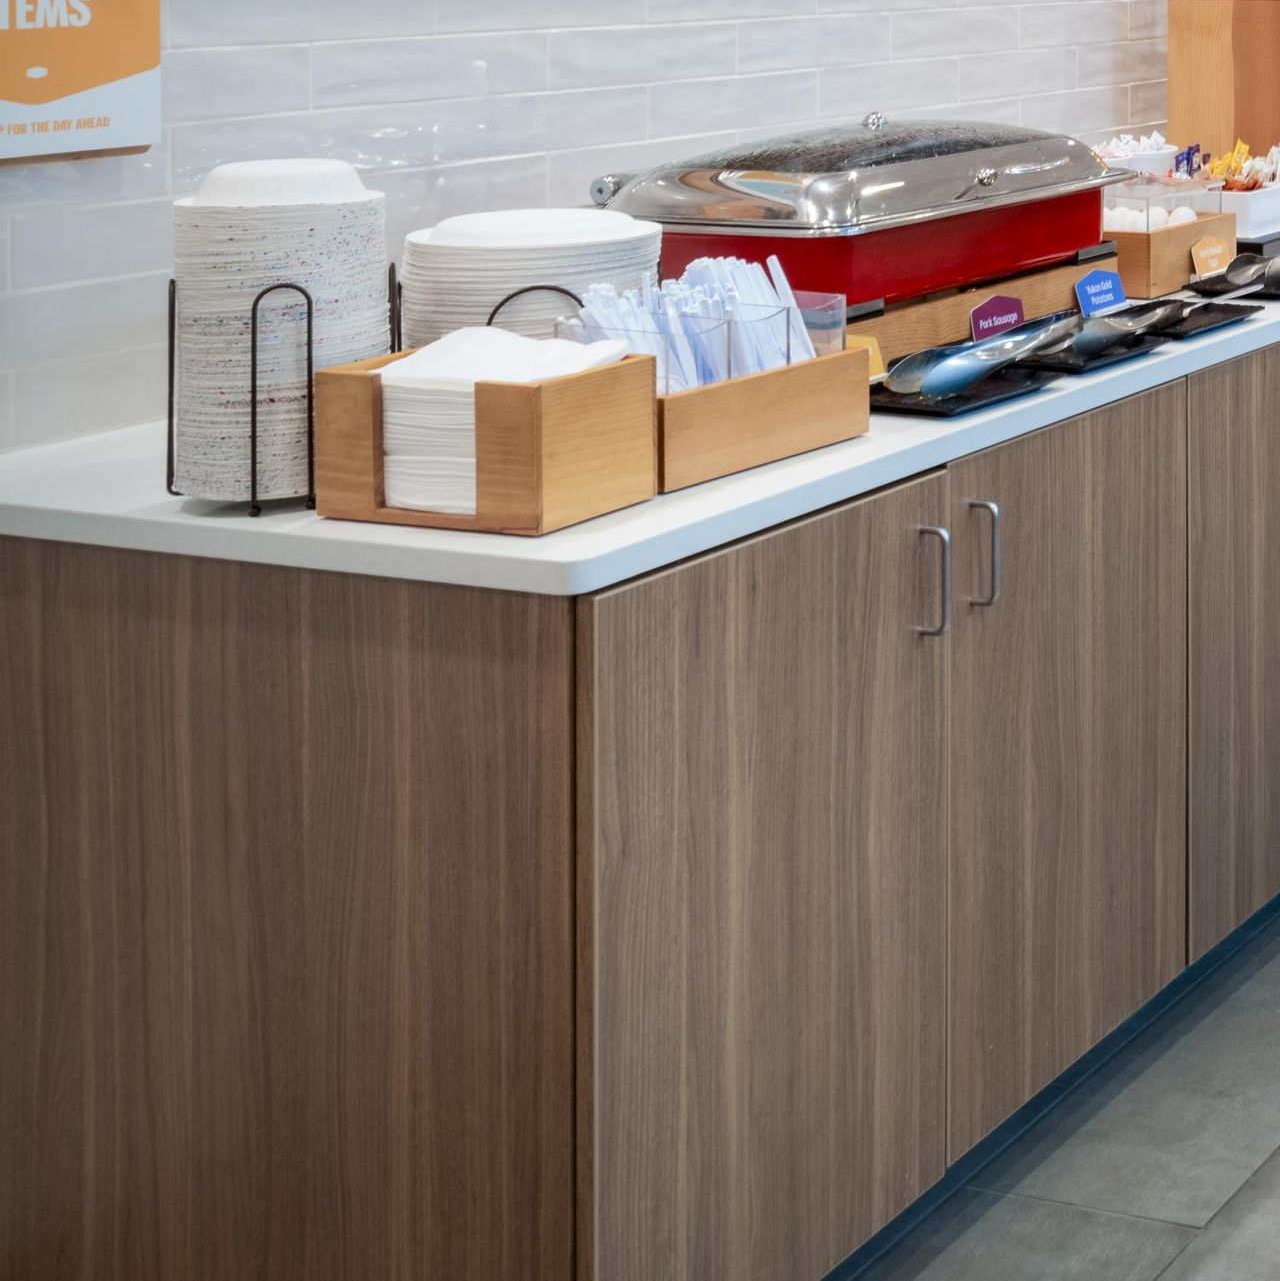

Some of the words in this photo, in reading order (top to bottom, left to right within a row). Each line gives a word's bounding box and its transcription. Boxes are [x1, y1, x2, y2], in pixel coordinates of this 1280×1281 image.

[8, 122, 28, 135] FOR
[31, 121, 50, 134] THE
[53, 119, 74, 132] DAY
[75, 116, 111, 130] AHEAD
[979, 317, 993, 330] Pork
[993, 312, 1018, 327] Sausage
